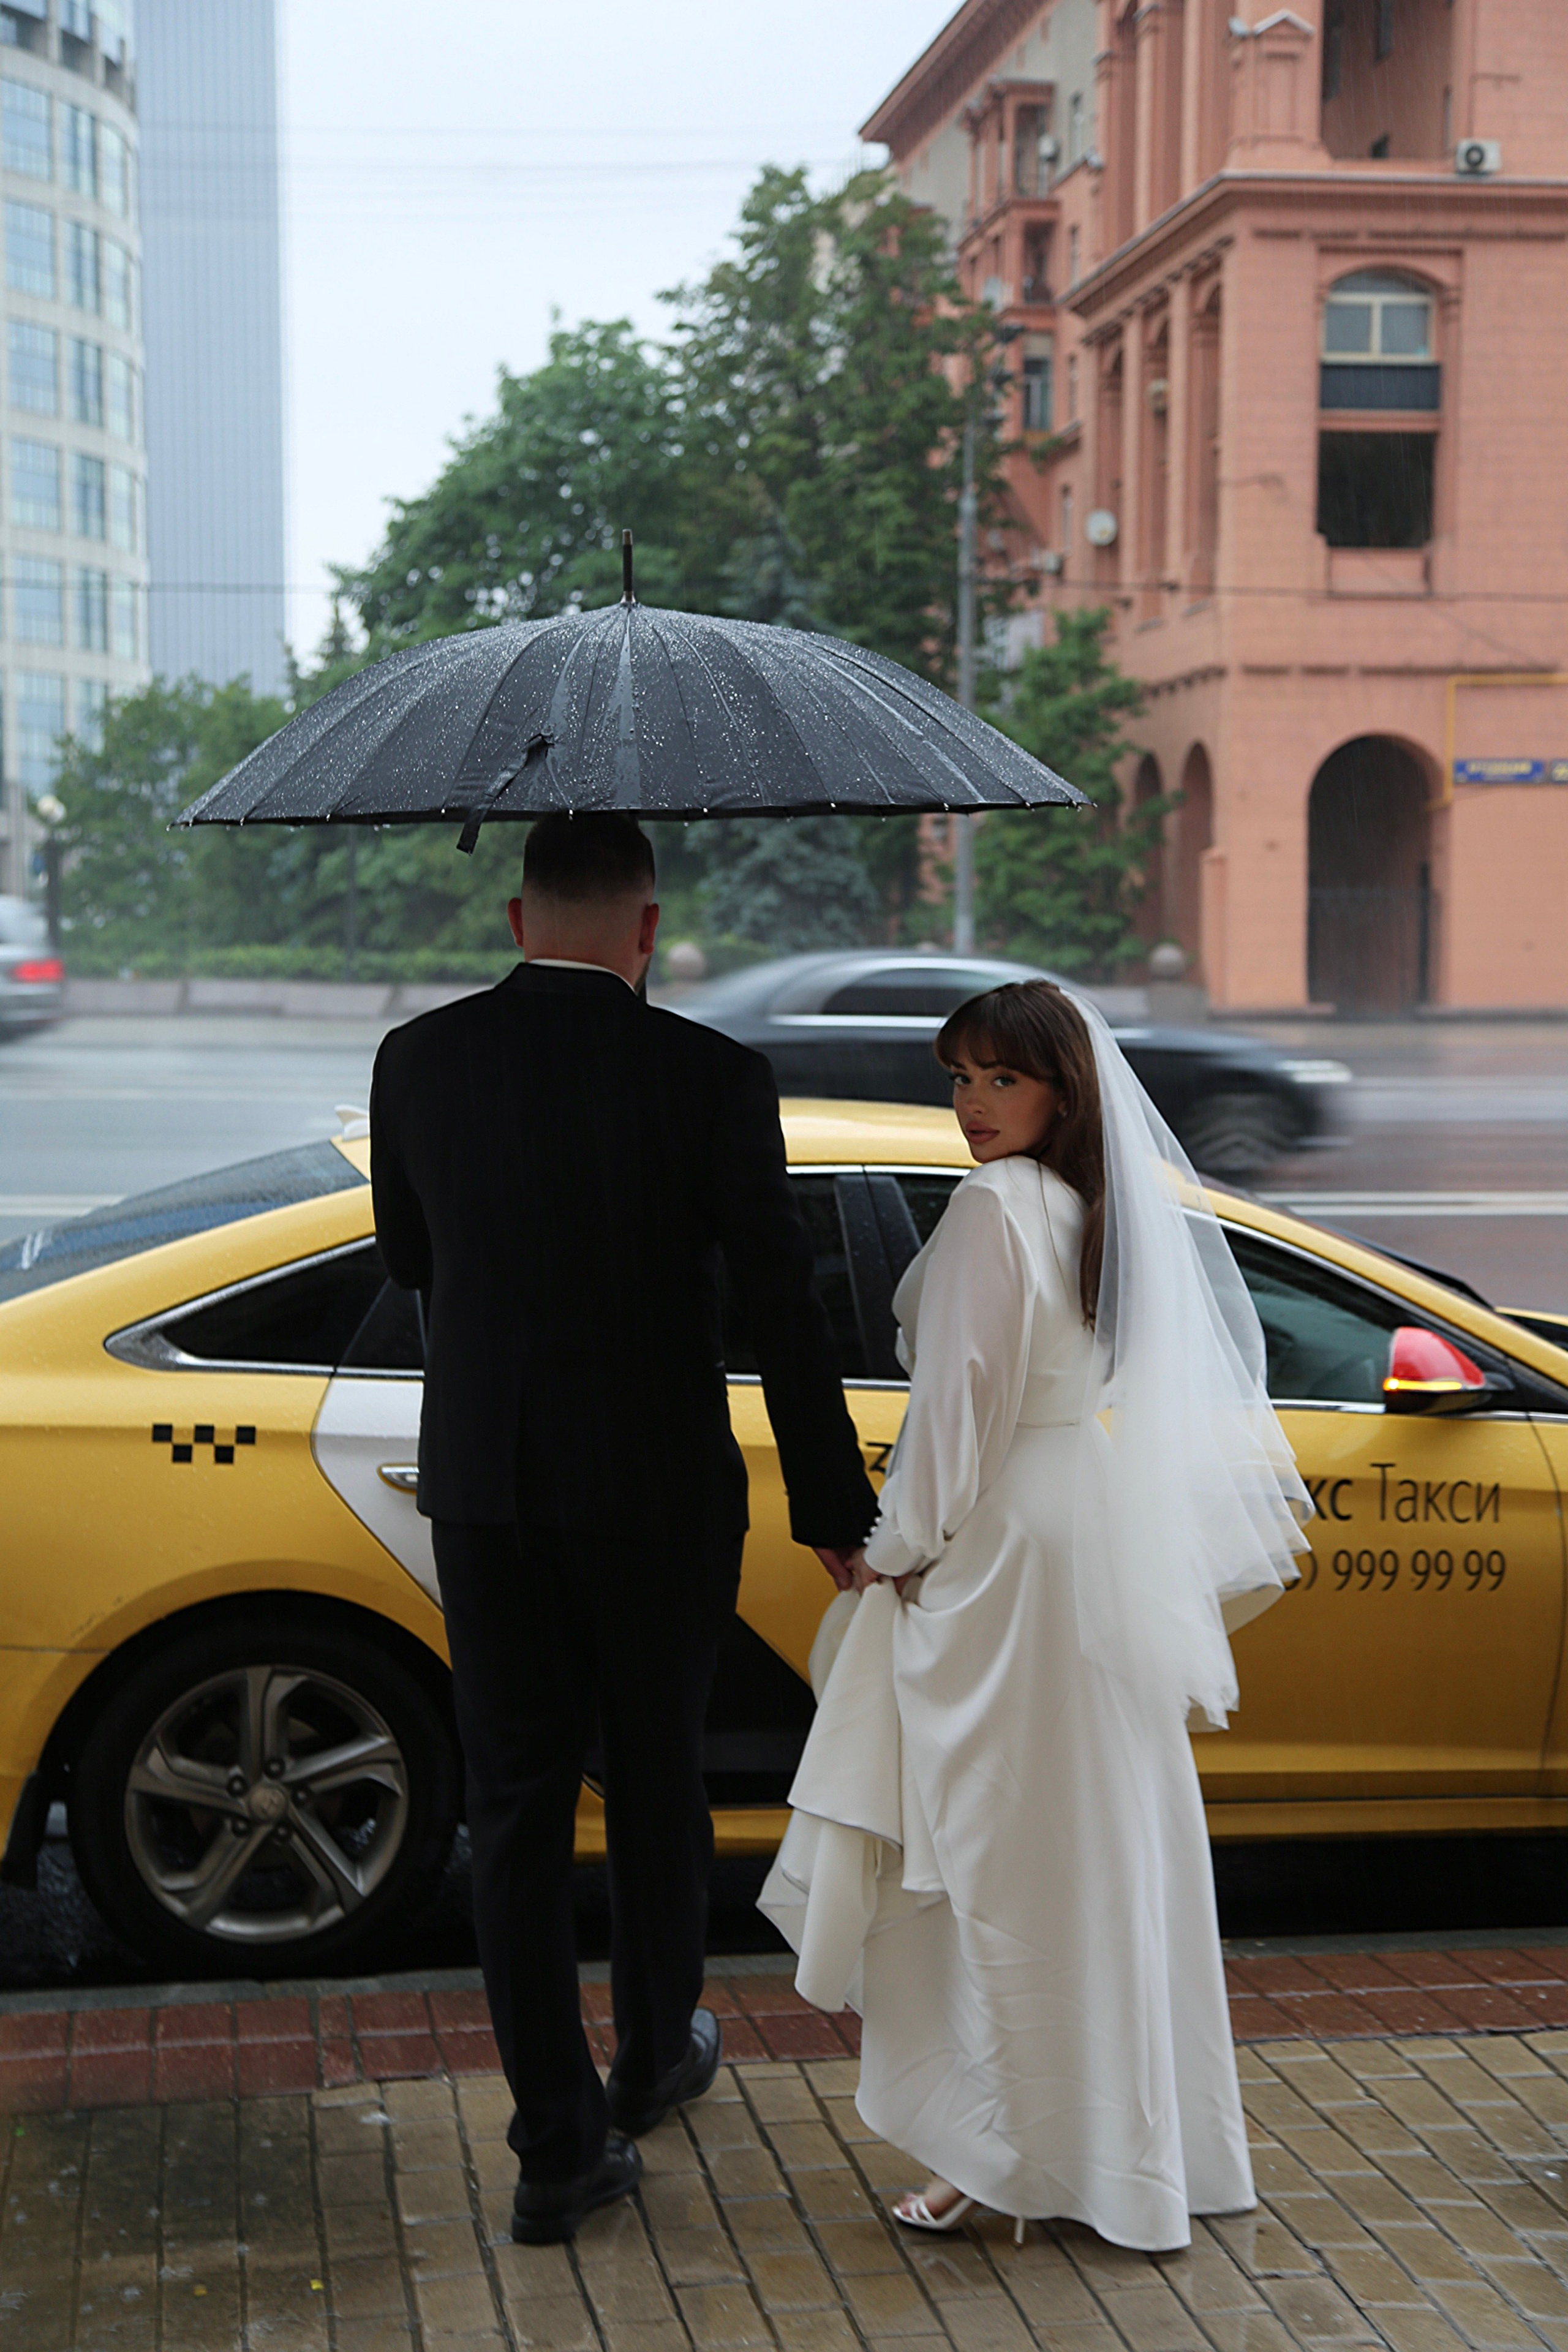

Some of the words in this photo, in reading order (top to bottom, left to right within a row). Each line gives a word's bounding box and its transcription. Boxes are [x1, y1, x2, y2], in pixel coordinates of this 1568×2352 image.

[1370, 1463, 1501, 1524] Такси
[1332, 1549, 1400, 1591] 999
[1410, 1549, 1454, 1591] 99
[1463, 1549, 1507, 1592] 99
